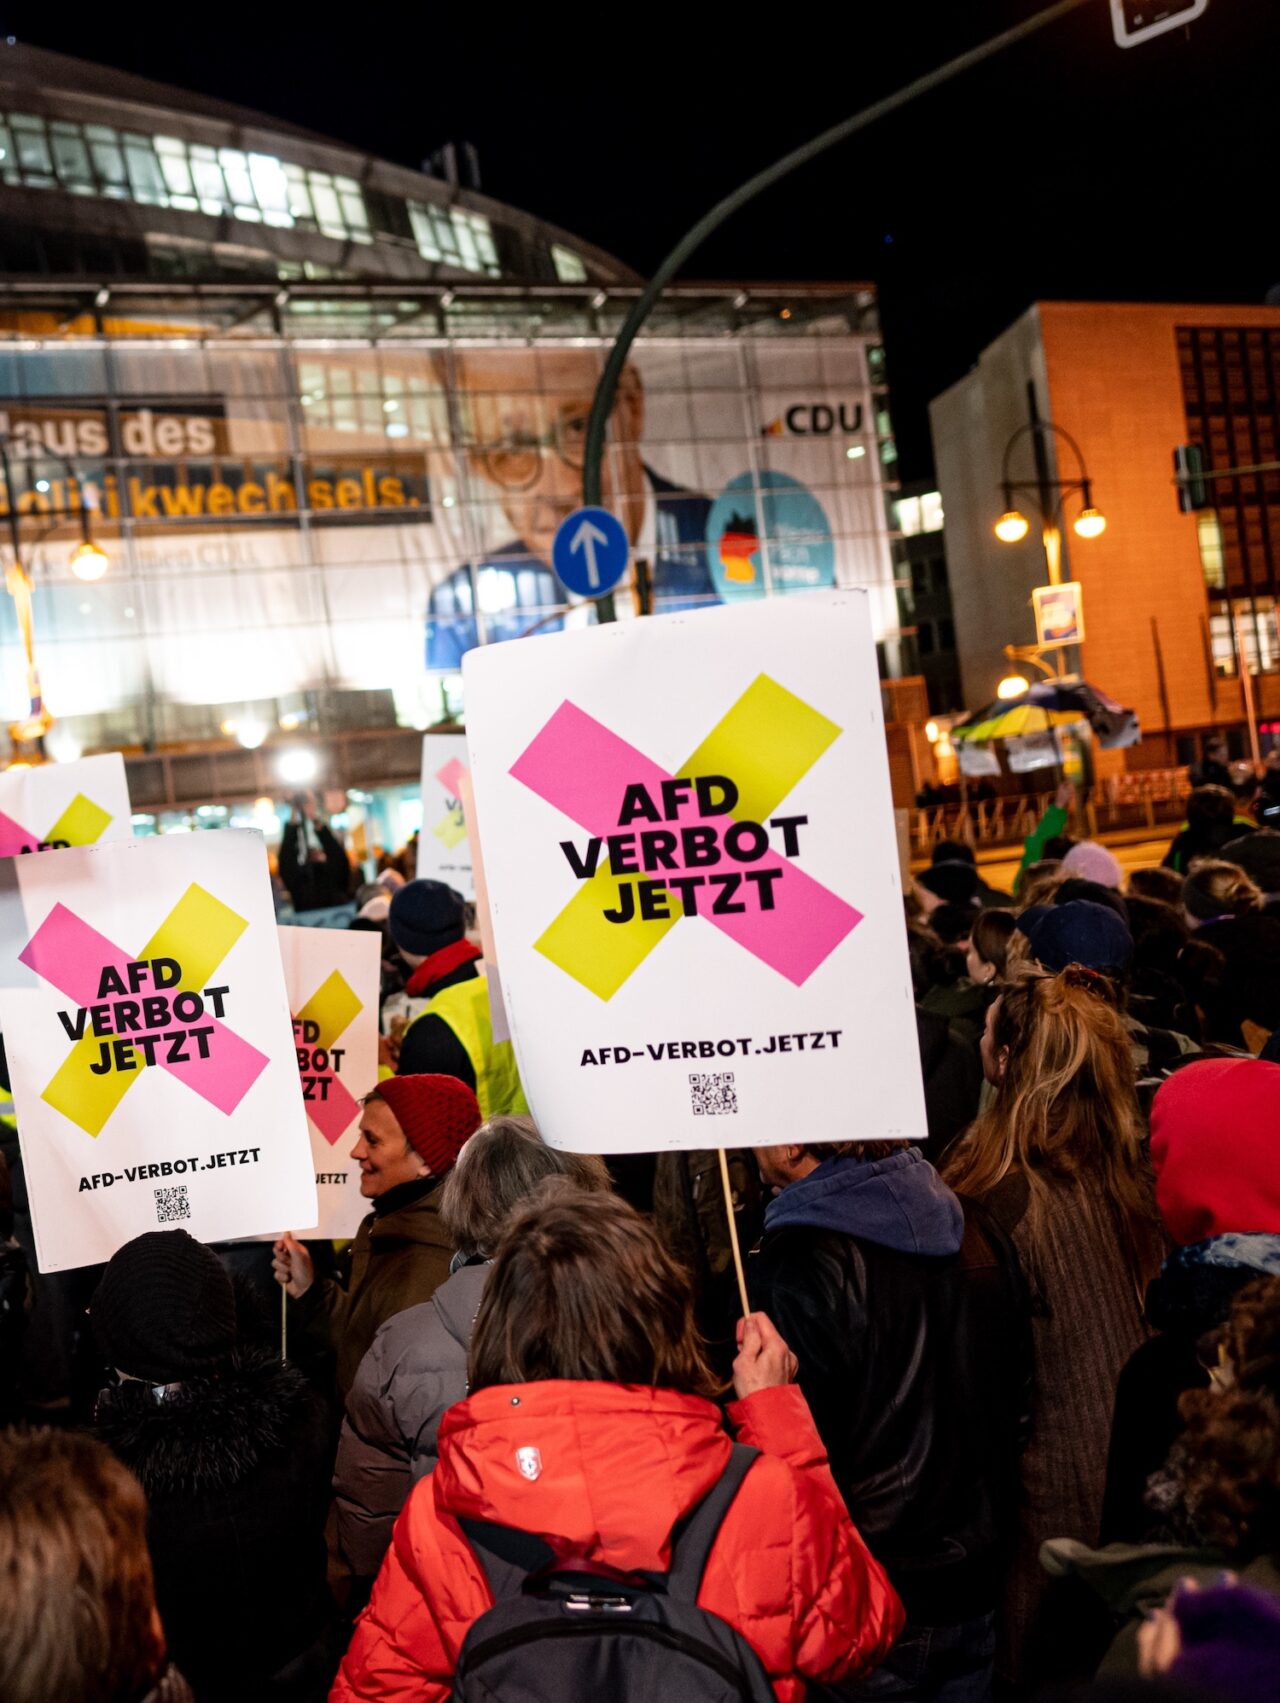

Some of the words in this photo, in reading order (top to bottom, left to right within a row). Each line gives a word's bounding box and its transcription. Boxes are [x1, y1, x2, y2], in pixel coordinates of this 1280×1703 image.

[123, 408, 217, 456] des
[785, 404, 863, 436] CDU
[619, 776, 738, 825] AFD
[560, 816, 807, 878] VERBOT
[604, 869, 782, 923] JETZT
[98, 958, 181, 998] AFD
[58, 986, 229, 1040] VERBOT
[291, 1019, 320, 1043] FD
[90, 1027, 214, 1074] JETZT
[581, 1031, 842, 1067] AFD-VERBOT.JETZT
[78, 1148, 260, 1192] AFD-VERBOT.JETZT
